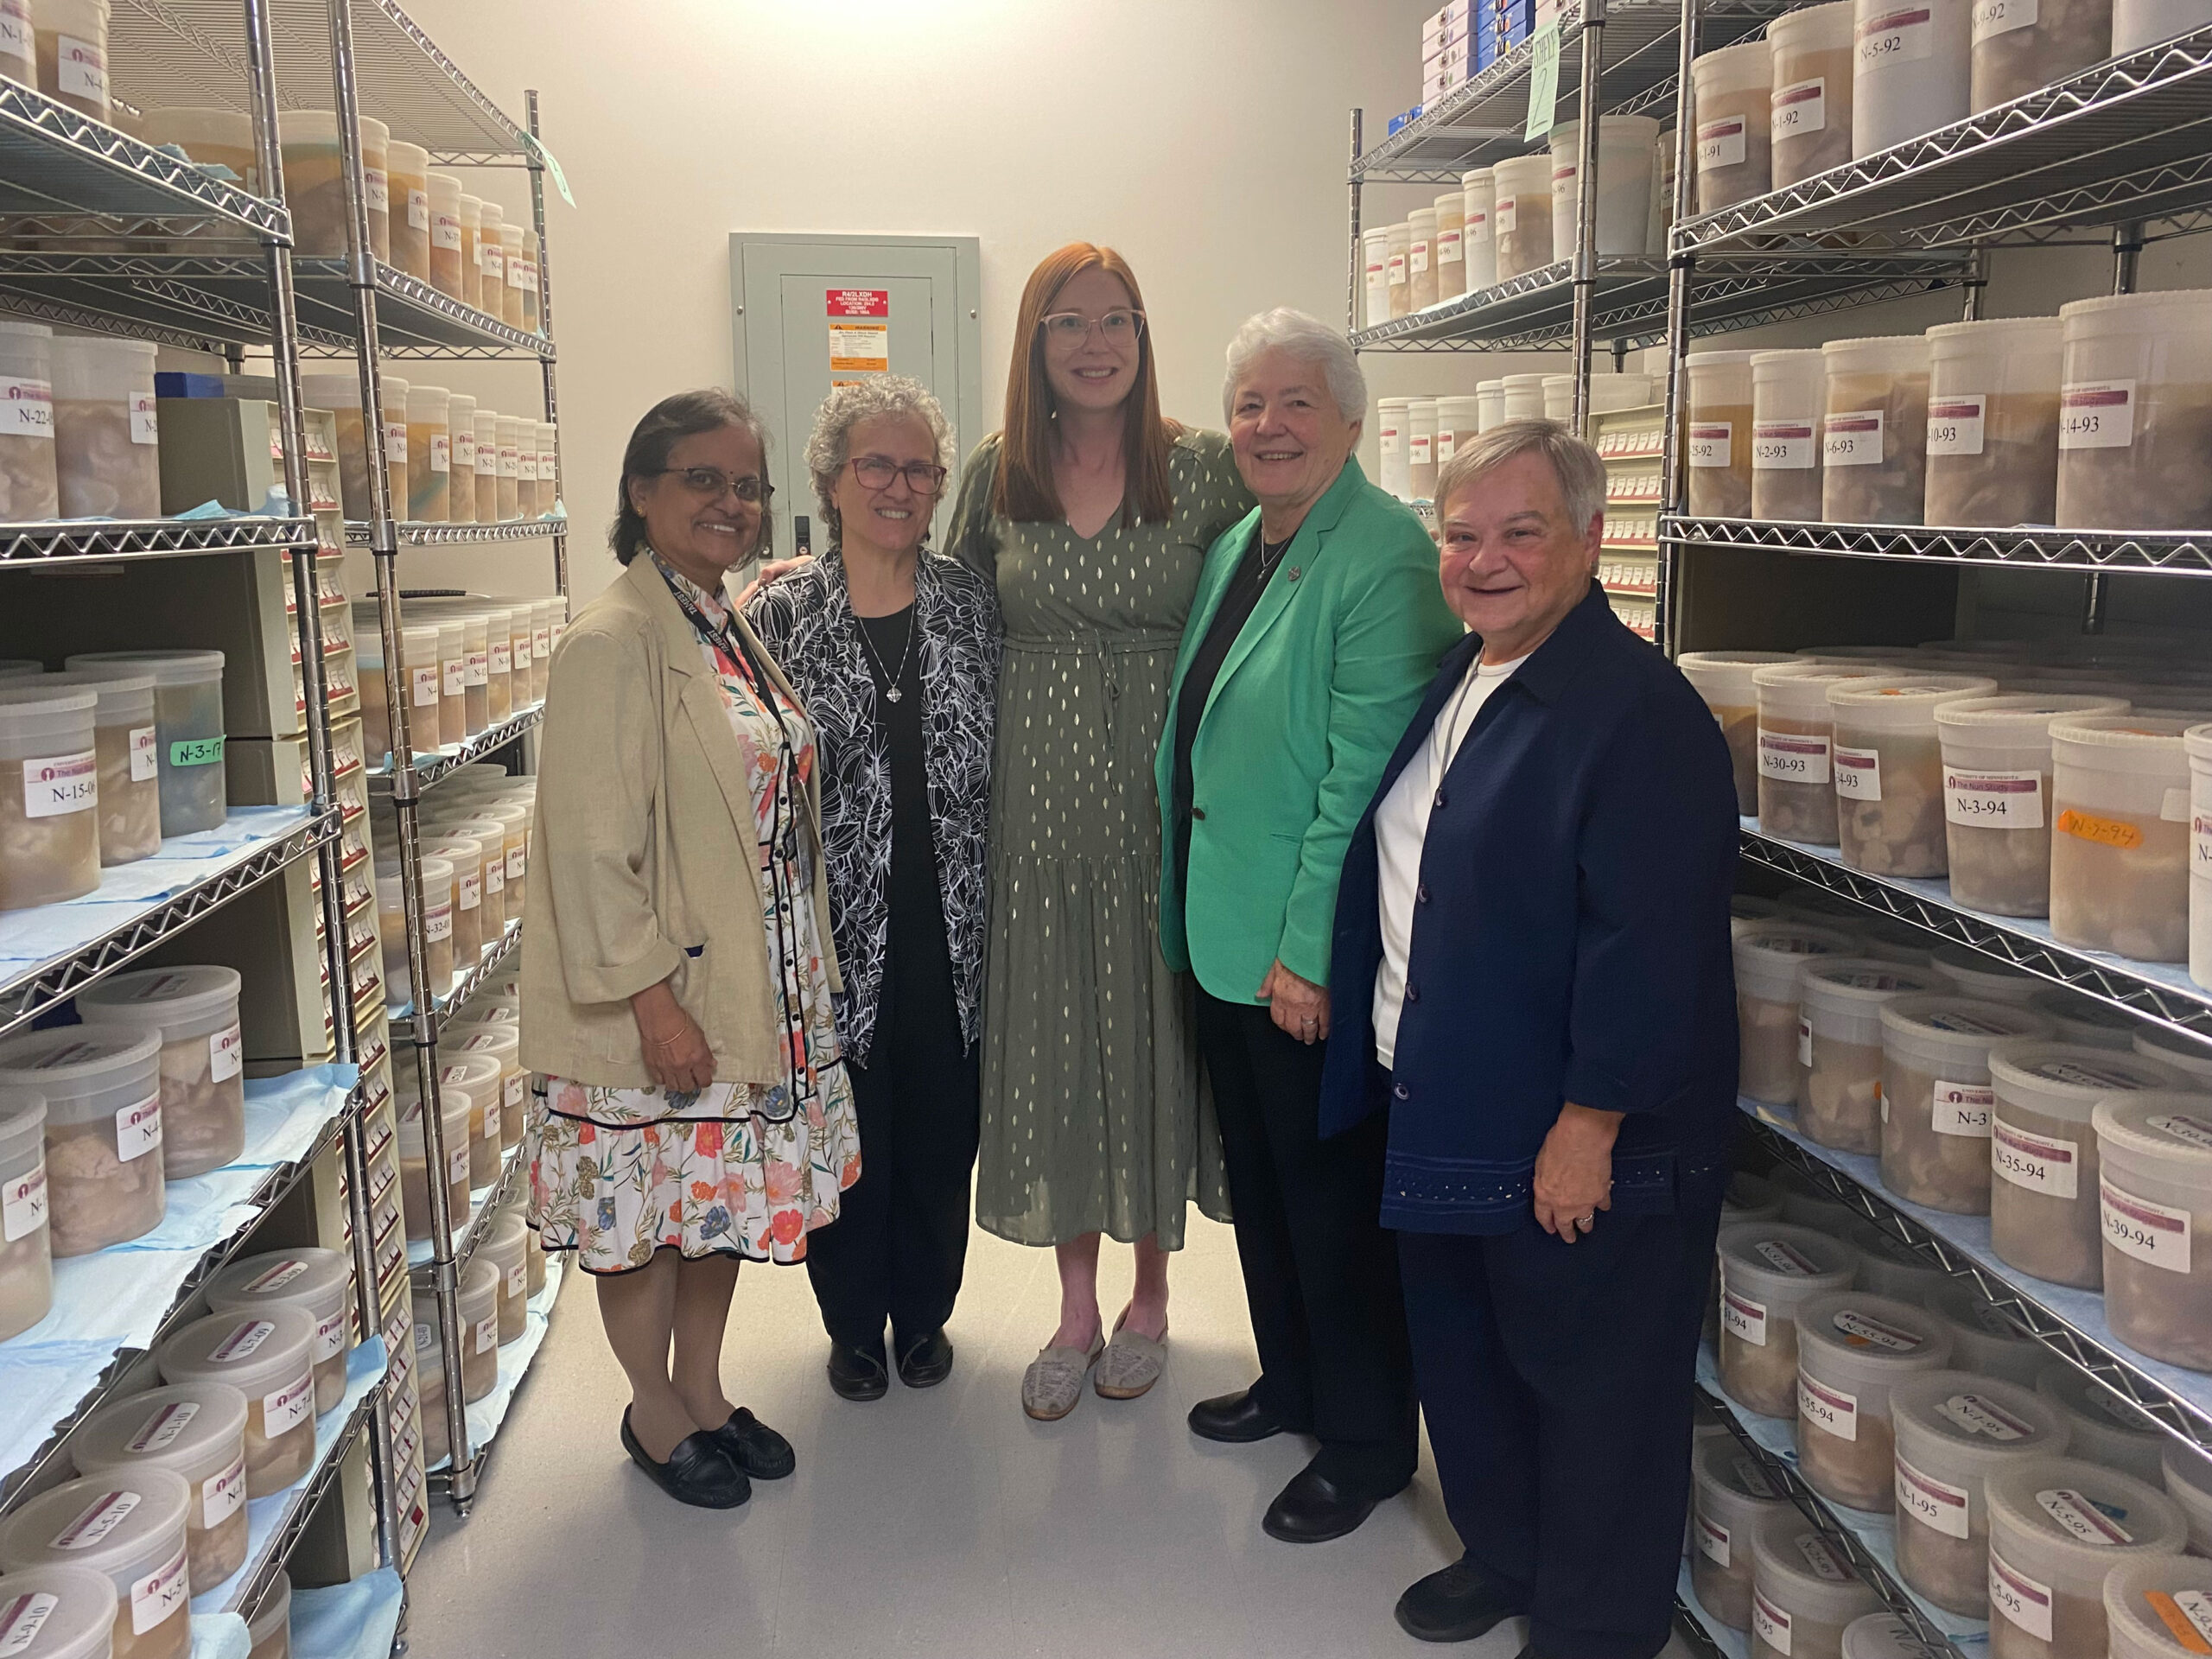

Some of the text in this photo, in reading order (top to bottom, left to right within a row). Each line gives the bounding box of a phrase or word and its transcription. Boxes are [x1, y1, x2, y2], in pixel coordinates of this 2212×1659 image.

[1534, 29, 1555, 68] SHELF
[1860, 36, 1901, 63] N-5-92
[1531, 68, 1548, 130] 2
[1756, 445, 1787, 458] N-2-93
[181, 741, 221, 762] N-3-17
[1763, 754, 1805, 772] N-30-93
[1985, 783, 2009, 791] Study
[1957, 798, 2007, 815] N-3-94
[1995, 1147, 2045, 1180] N-35-94
[2103, 1210, 2155, 1250] N-39-94
[158, 1412, 190, 1442] N-1-10
[1957, 1406, 2004, 1433] N-1-95
[1899, 1481, 1937, 1517] N-1-95
[86, 1503, 130, 1538] N-5-10
[2045, 1501, 2091, 1534] N-5-95
[11, 1606, 48, 1645] N-9-10
